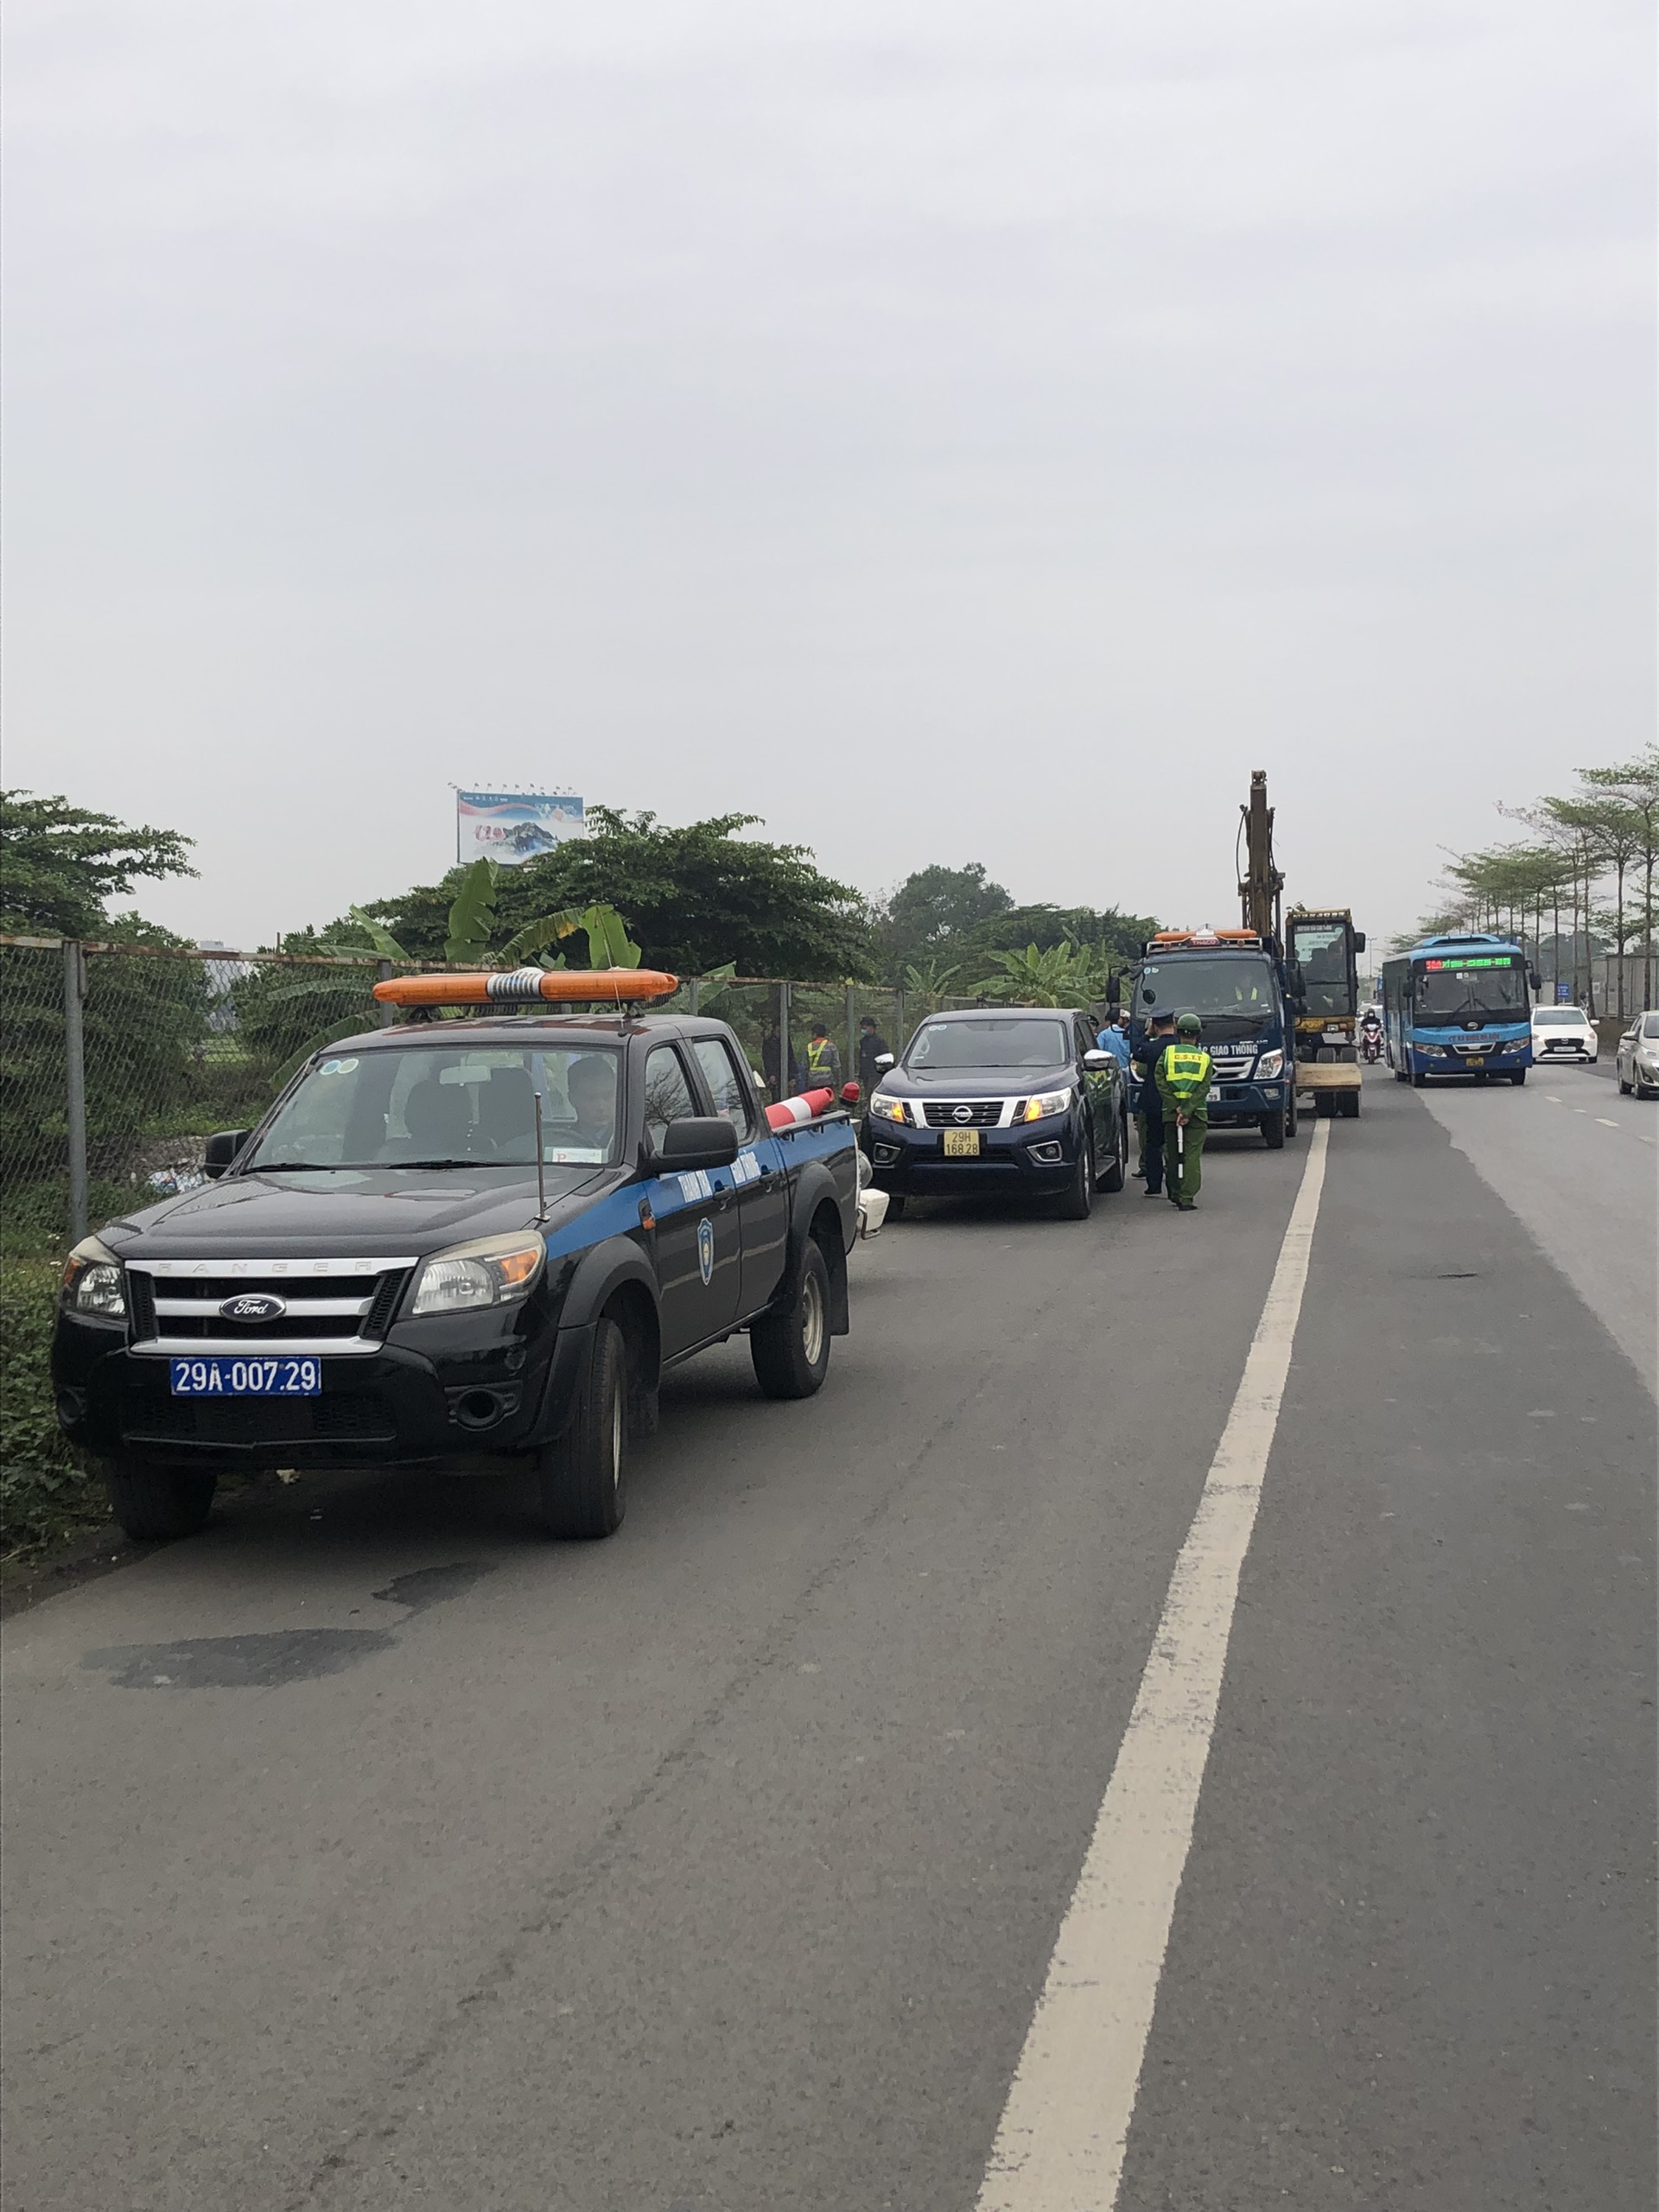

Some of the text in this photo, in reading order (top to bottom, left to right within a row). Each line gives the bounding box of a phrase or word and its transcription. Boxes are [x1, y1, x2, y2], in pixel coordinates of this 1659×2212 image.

[1211, 1046, 1229, 1056] GIAO
[952, 1132, 971, 1142] 29H
[157, 1261, 372, 1274] RANGER
[233, 1300, 267, 1315] Ford
[175, 1361, 315, 1392] 29A-007.29
